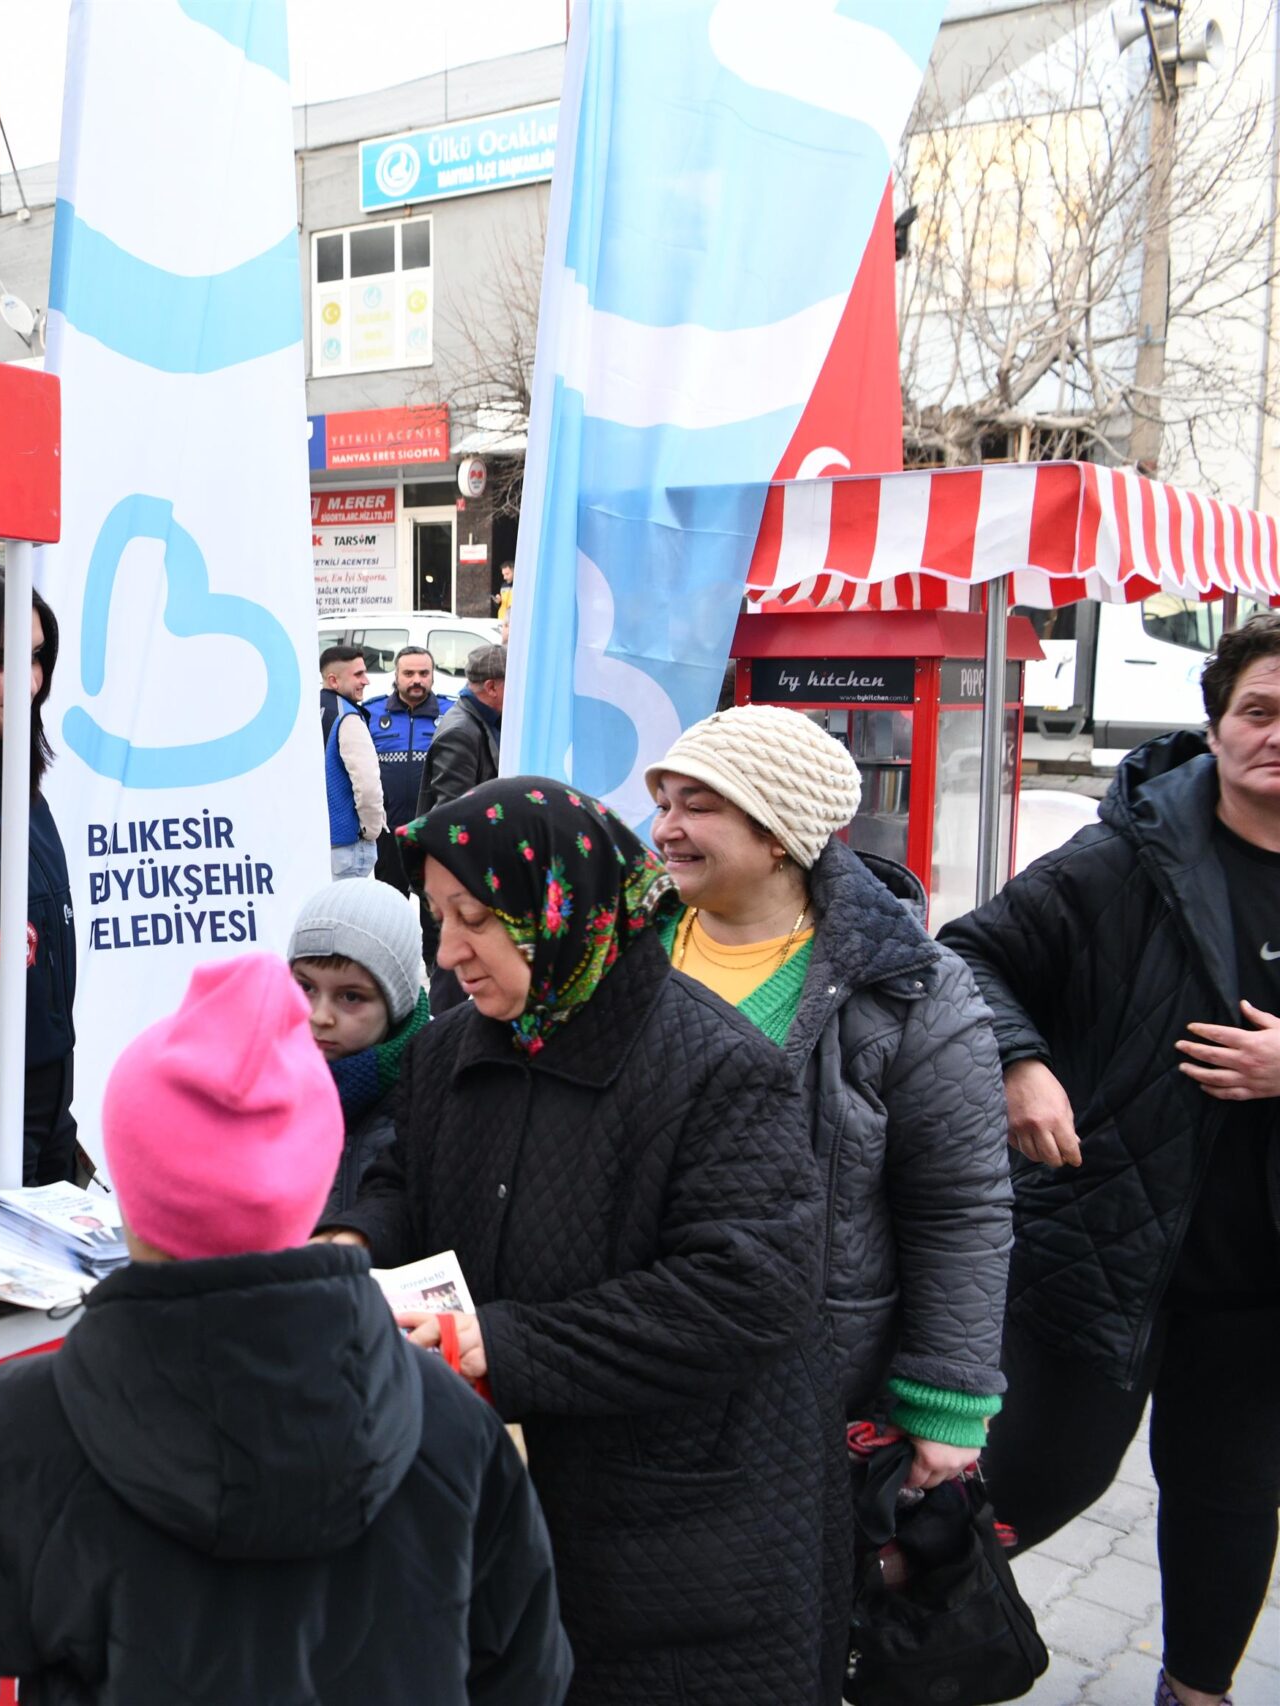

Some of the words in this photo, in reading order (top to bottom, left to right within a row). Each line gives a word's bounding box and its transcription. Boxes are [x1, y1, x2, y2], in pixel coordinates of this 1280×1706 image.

[331, 431, 383, 446] YETKİLİ
[387, 427, 442, 441] ACENTE
[332, 452, 370, 465] MANYAS
[398, 447, 441, 459] SİGORTA
[328, 495, 387, 510] M.ERER
[341, 556, 379, 565] ACENTESİ
[340, 585, 368, 595] POLİÇESİ
[343, 597, 358, 605] KART
[360, 596, 393, 605] SİGORTASI
[778, 670, 800, 692] by
[807, 671, 884, 687] kitchen
[960, 669, 984, 696] POPC
[839, 694, 910, 702] www.bykitchen.com.tr
[89, 901, 257, 952] ELEDİYESİ
